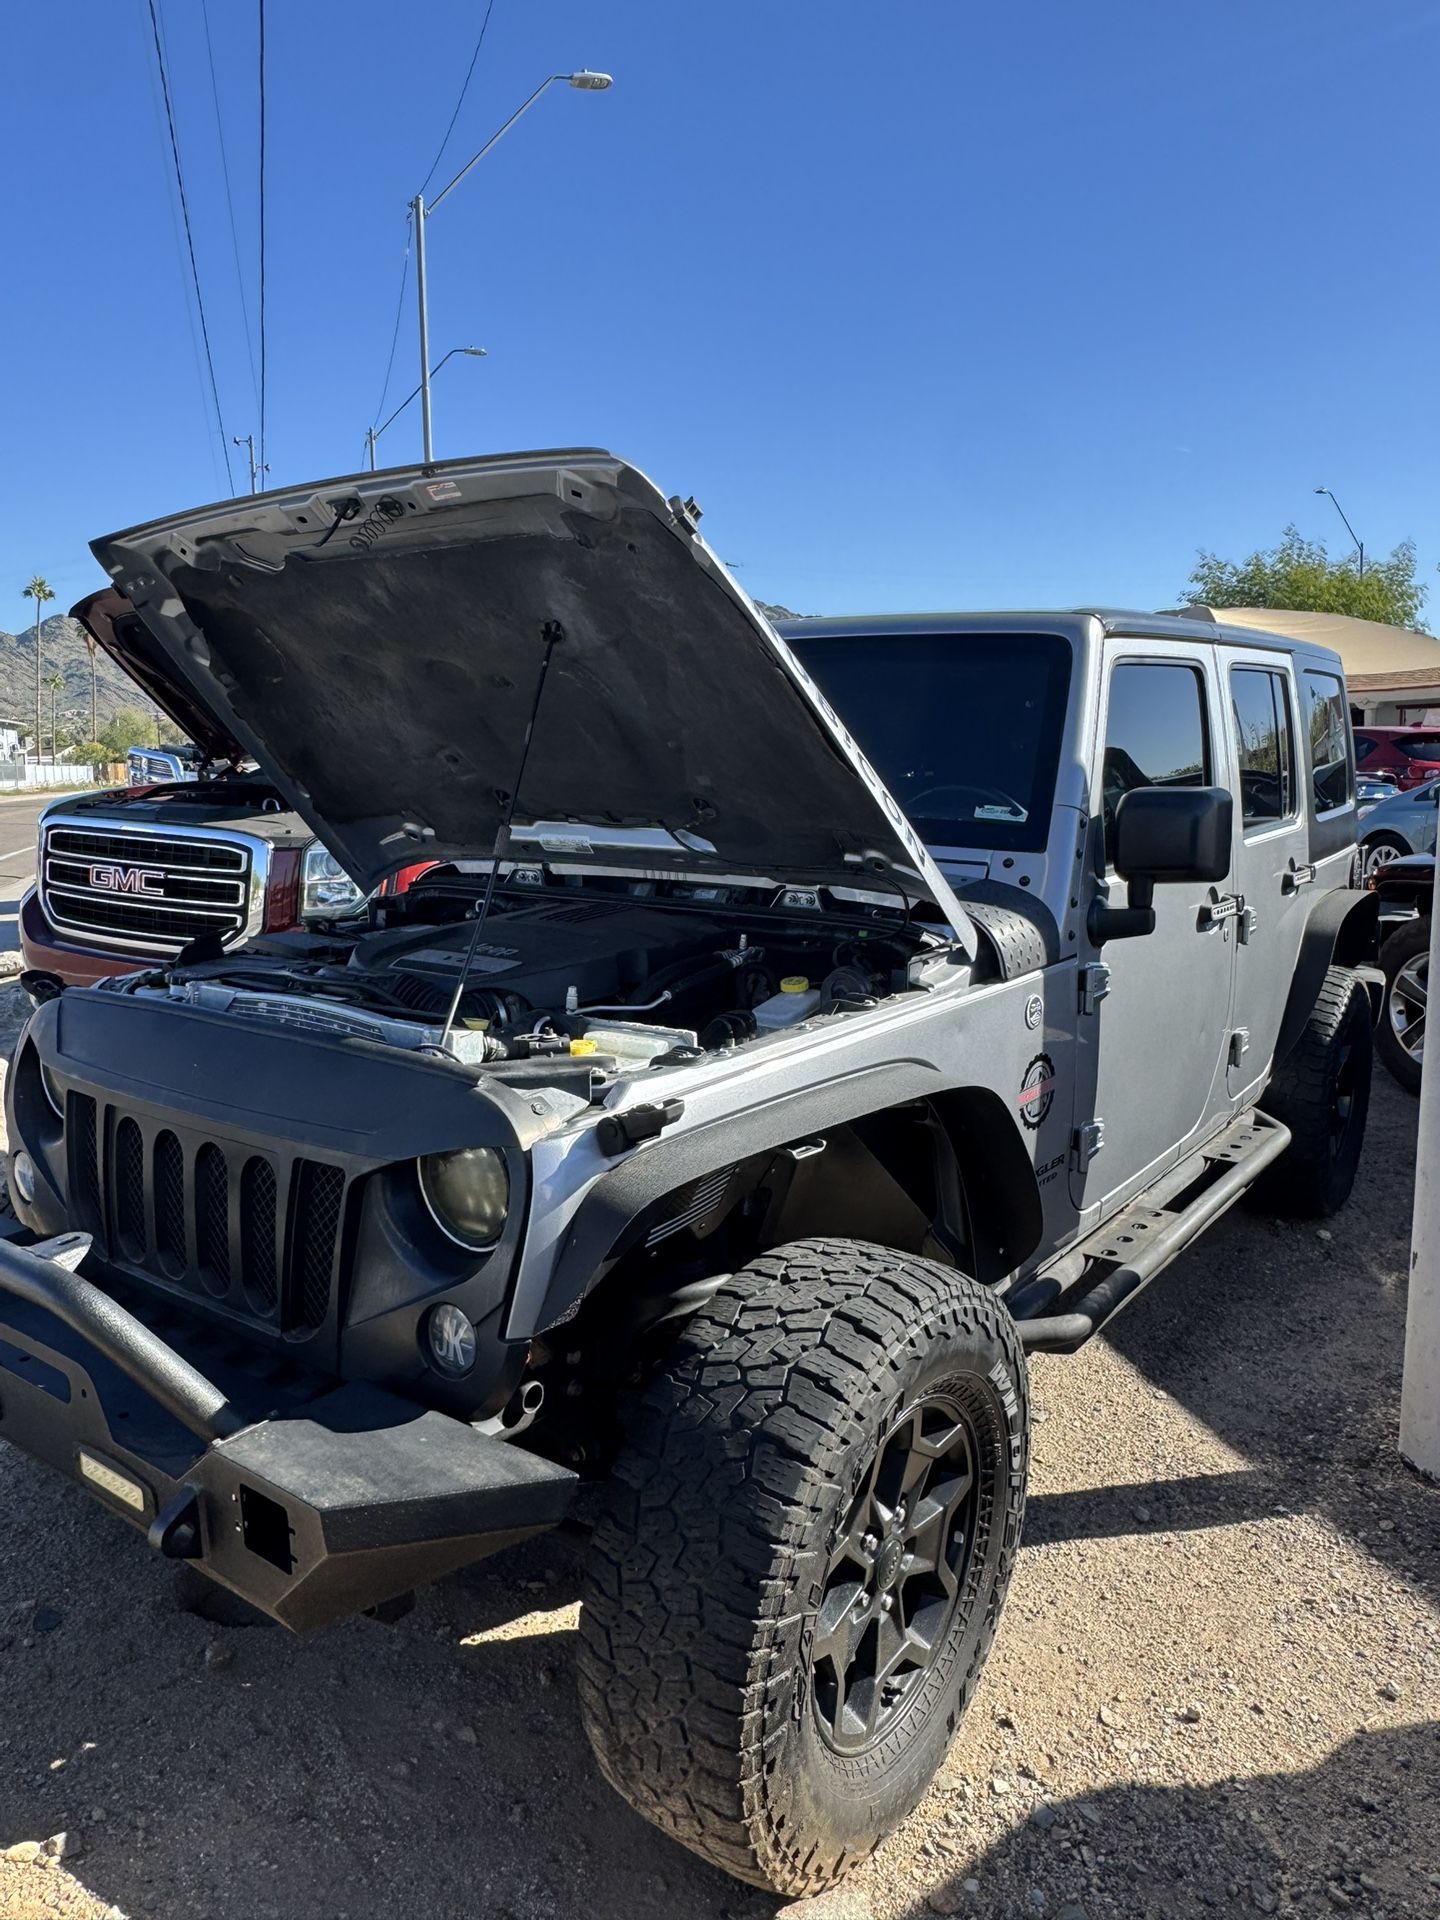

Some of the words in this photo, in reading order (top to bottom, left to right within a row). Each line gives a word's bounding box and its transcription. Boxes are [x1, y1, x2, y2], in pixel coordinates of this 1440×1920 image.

[90, 864, 165, 896] GMC
[1036, 1153, 1065, 1177] GLER
[435, 1317, 467, 1366] JK
